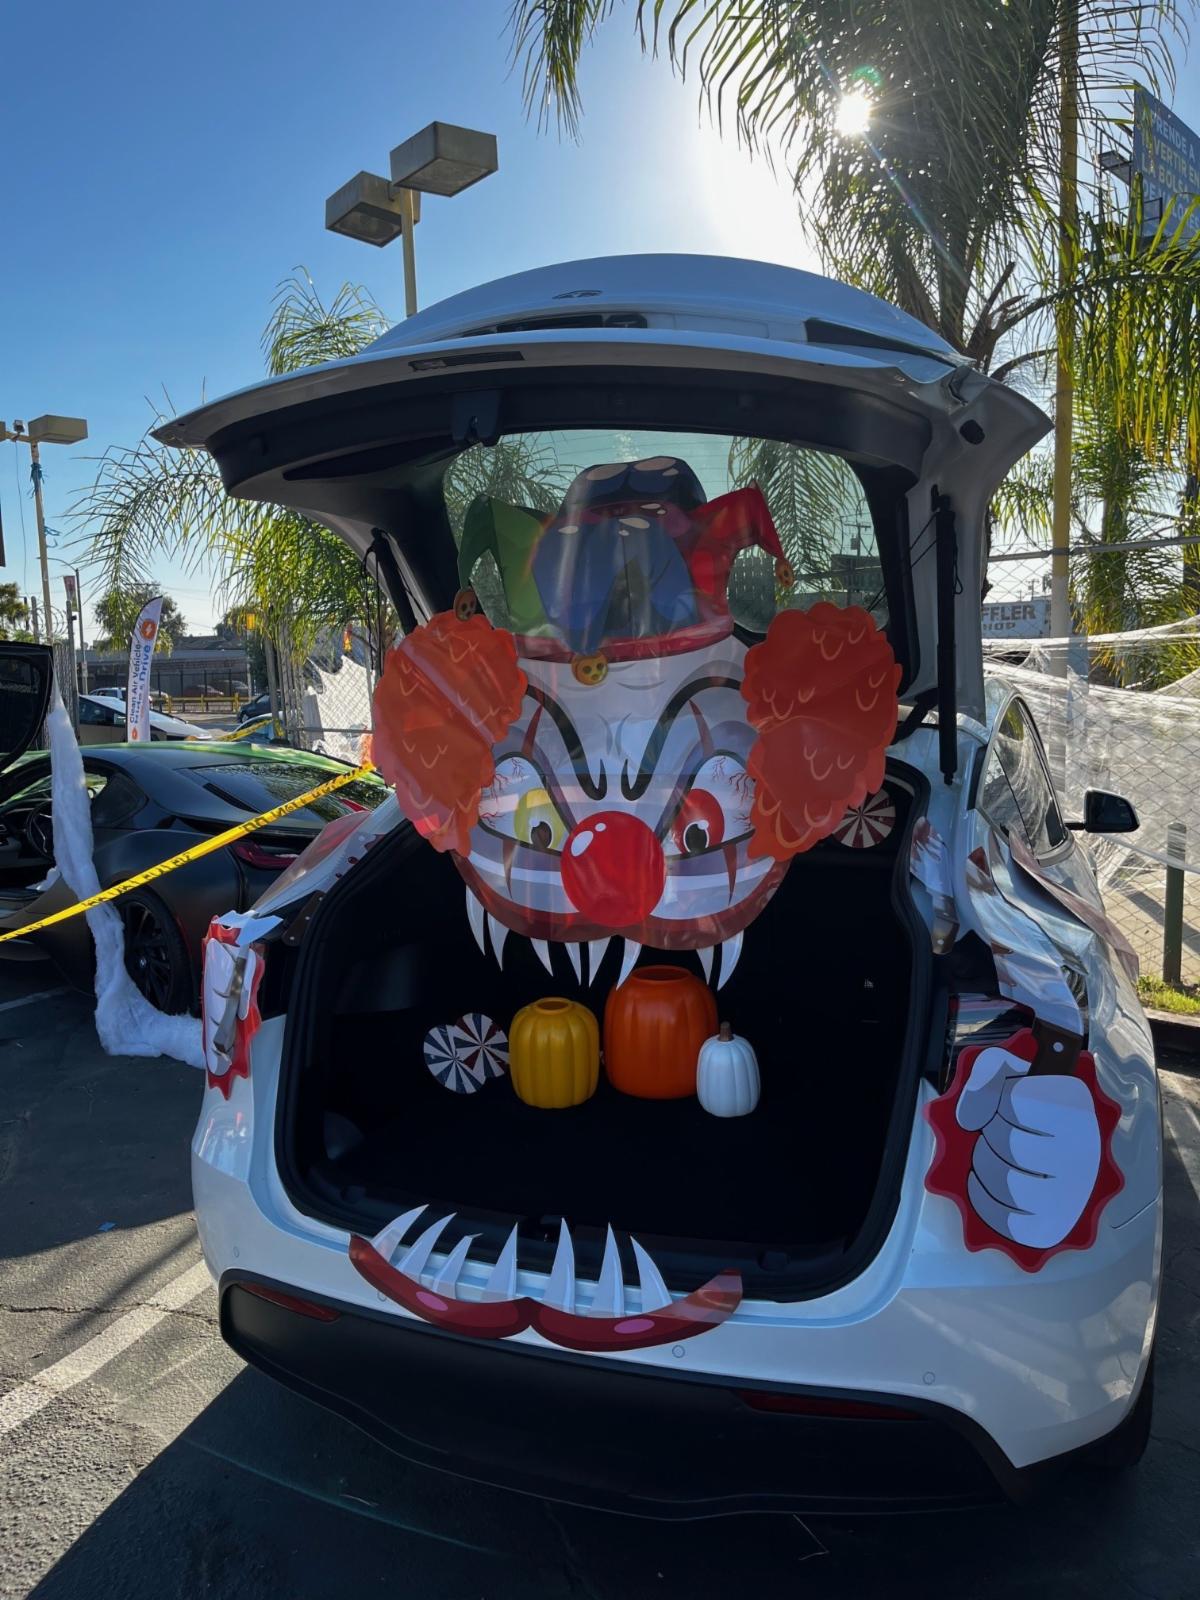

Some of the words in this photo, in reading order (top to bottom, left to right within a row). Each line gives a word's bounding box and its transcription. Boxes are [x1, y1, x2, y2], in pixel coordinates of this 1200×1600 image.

[1189, 143, 1196, 164] A
[139, 645, 151, 681] Drive
[131, 681, 139, 694] Air
